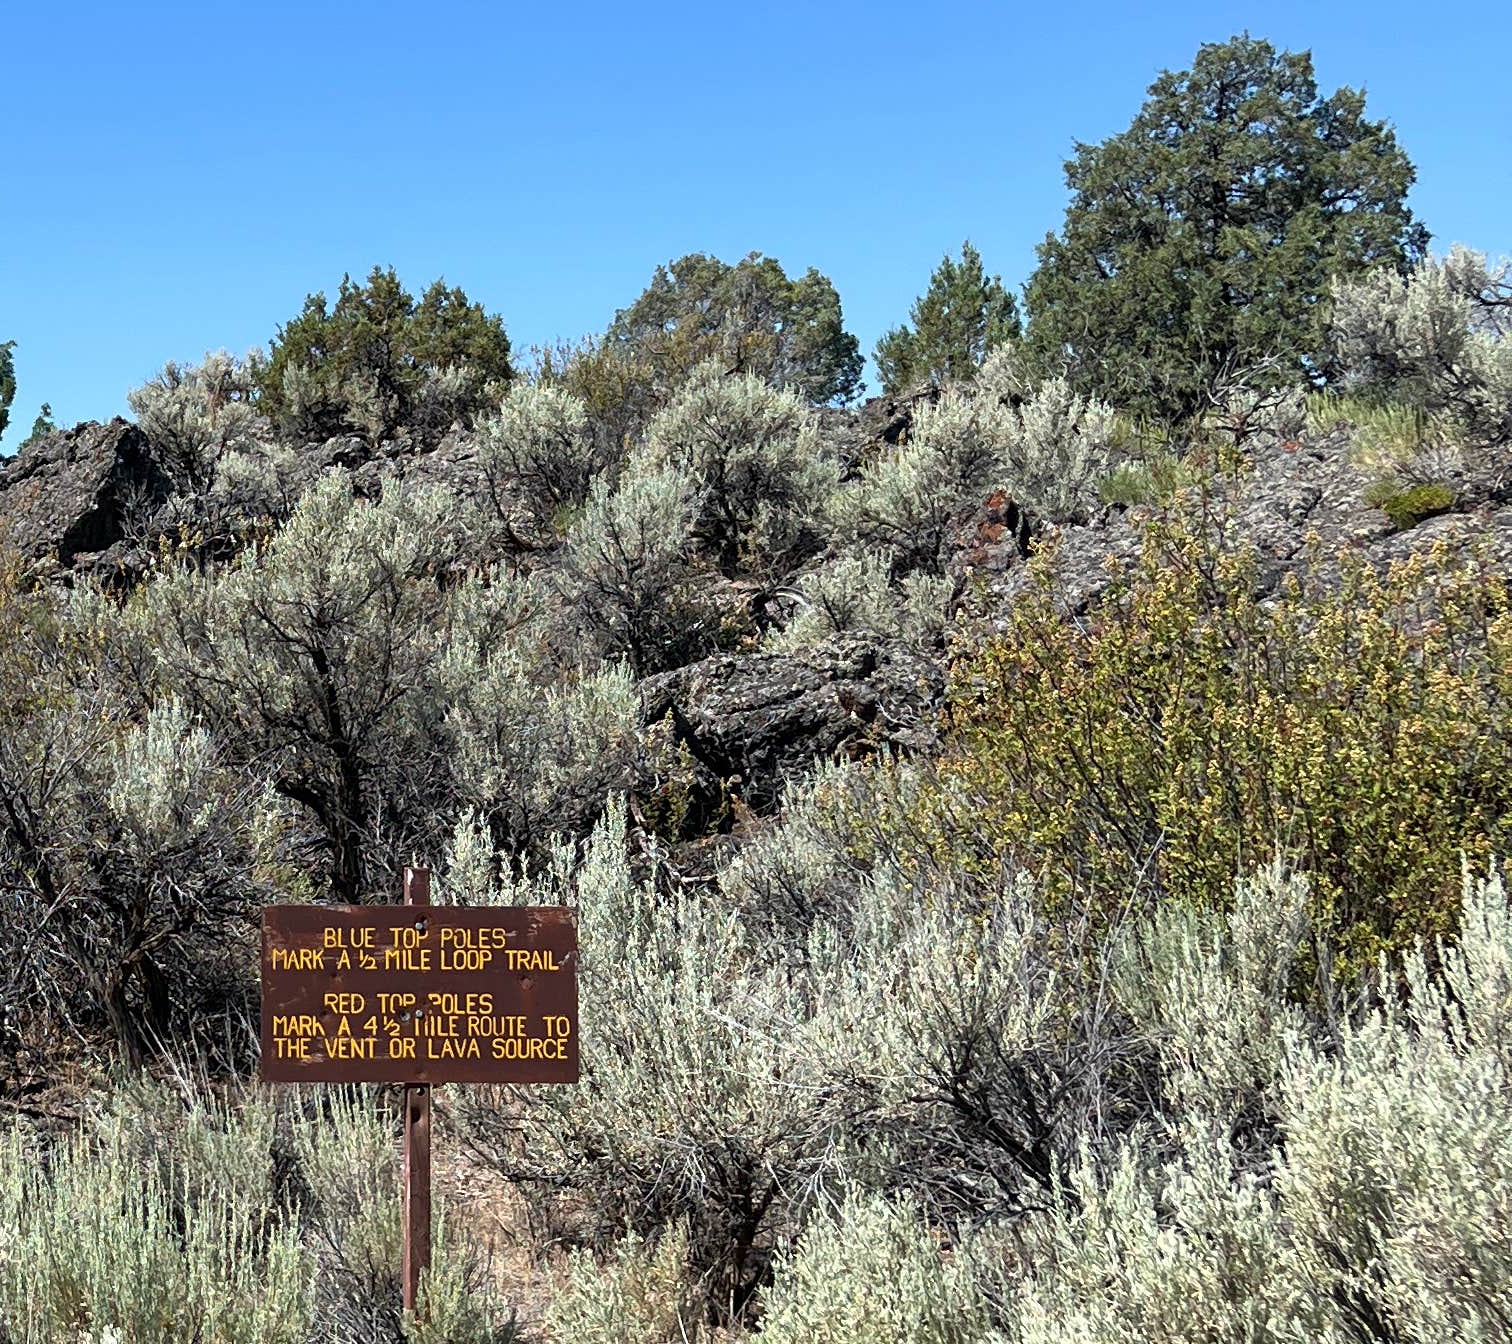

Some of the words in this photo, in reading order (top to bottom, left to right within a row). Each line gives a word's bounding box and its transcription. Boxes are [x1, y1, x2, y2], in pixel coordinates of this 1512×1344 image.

[323, 928, 376, 948] BLUE
[389, 928, 428, 948] TOP
[441, 928, 506, 948] POLES
[272, 949, 324, 970] MARK
[337, 950, 351, 969] A
[385, 950, 431, 970] MILE
[441, 950, 492, 970] LOOP
[504, 950, 559, 970] TRAIL
[324, 994, 364, 1014] RED
[377, 994, 415, 1014] TOP
[428, 994, 493, 1014] POLES
[273, 1016, 325, 1036] MARK
[338, 1016, 351, 1036] A
[468, 1016, 526, 1037] ROUTE
[543, 1017, 570, 1037] TO
[273, 1038, 311, 1058] THE
[325, 1039, 377, 1059] VENT
[389, 1039, 415, 1059] OR
[428, 1039, 480, 1059] LAVA
[492, 1039, 568, 1059] SOURCE
